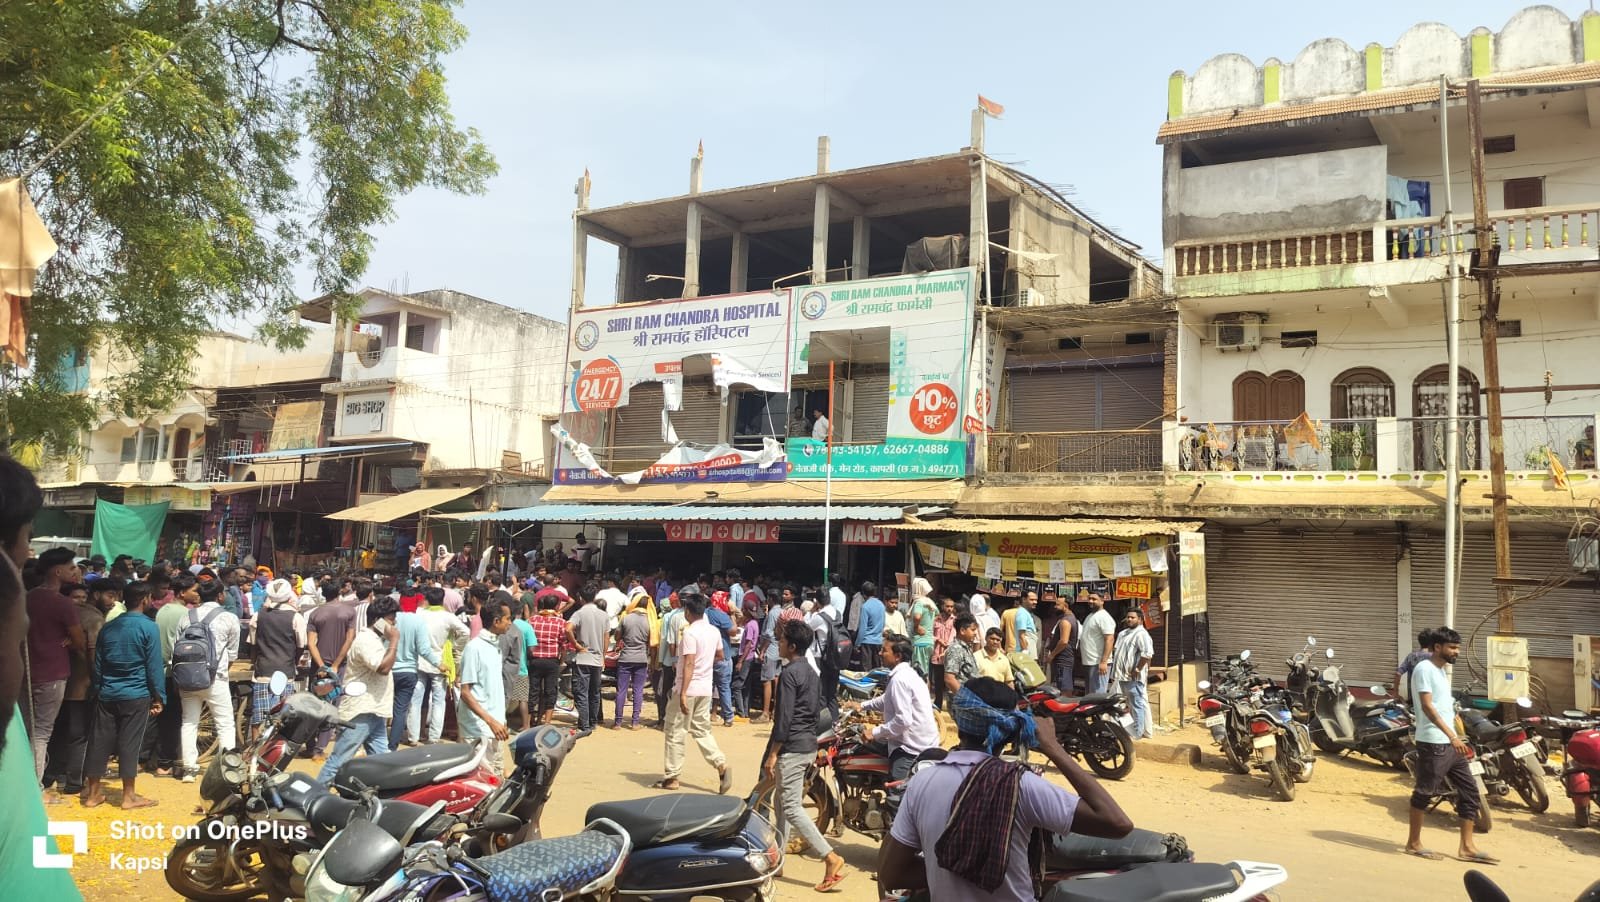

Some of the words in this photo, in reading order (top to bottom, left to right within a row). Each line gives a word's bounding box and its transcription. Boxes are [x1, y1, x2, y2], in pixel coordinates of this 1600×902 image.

[831, 290, 850, 301] SHRI
[851, 288, 871, 300] RAM
[873, 284, 913, 299] CHANDRA
[915, 279, 967, 295] PHARMACY
[846, 303, 858, 315] श्री
[861, 301, 893, 314] रामचंद्र
[607, 317, 632, 333] SHRI
[635, 314, 661, 330] RAM
[664, 308, 720, 327] CHANDRA
[724, 302, 782, 321] HOSPITAL
[632, 331, 648, 347] श्री
[652, 327, 691, 346] रामचंद्र
[694, 324, 749, 342] हॉस्पिटल
[584, 366, 617, 375] EMERGENCY
[579, 376, 620, 401] 24/7
[346, 402, 361, 415] BIG
[362, 400, 386, 414] SHOP
[585, 401, 611, 409] SERVICES
[914, 388, 957, 413] 10%
[883, 444, 950, 455] 62667-04886
[928, 464, 959, 474] 494771
[685, 523, 713, 540] IPD
[731, 523, 767, 541] OPD
[998, 537, 1058, 557] Supreme
